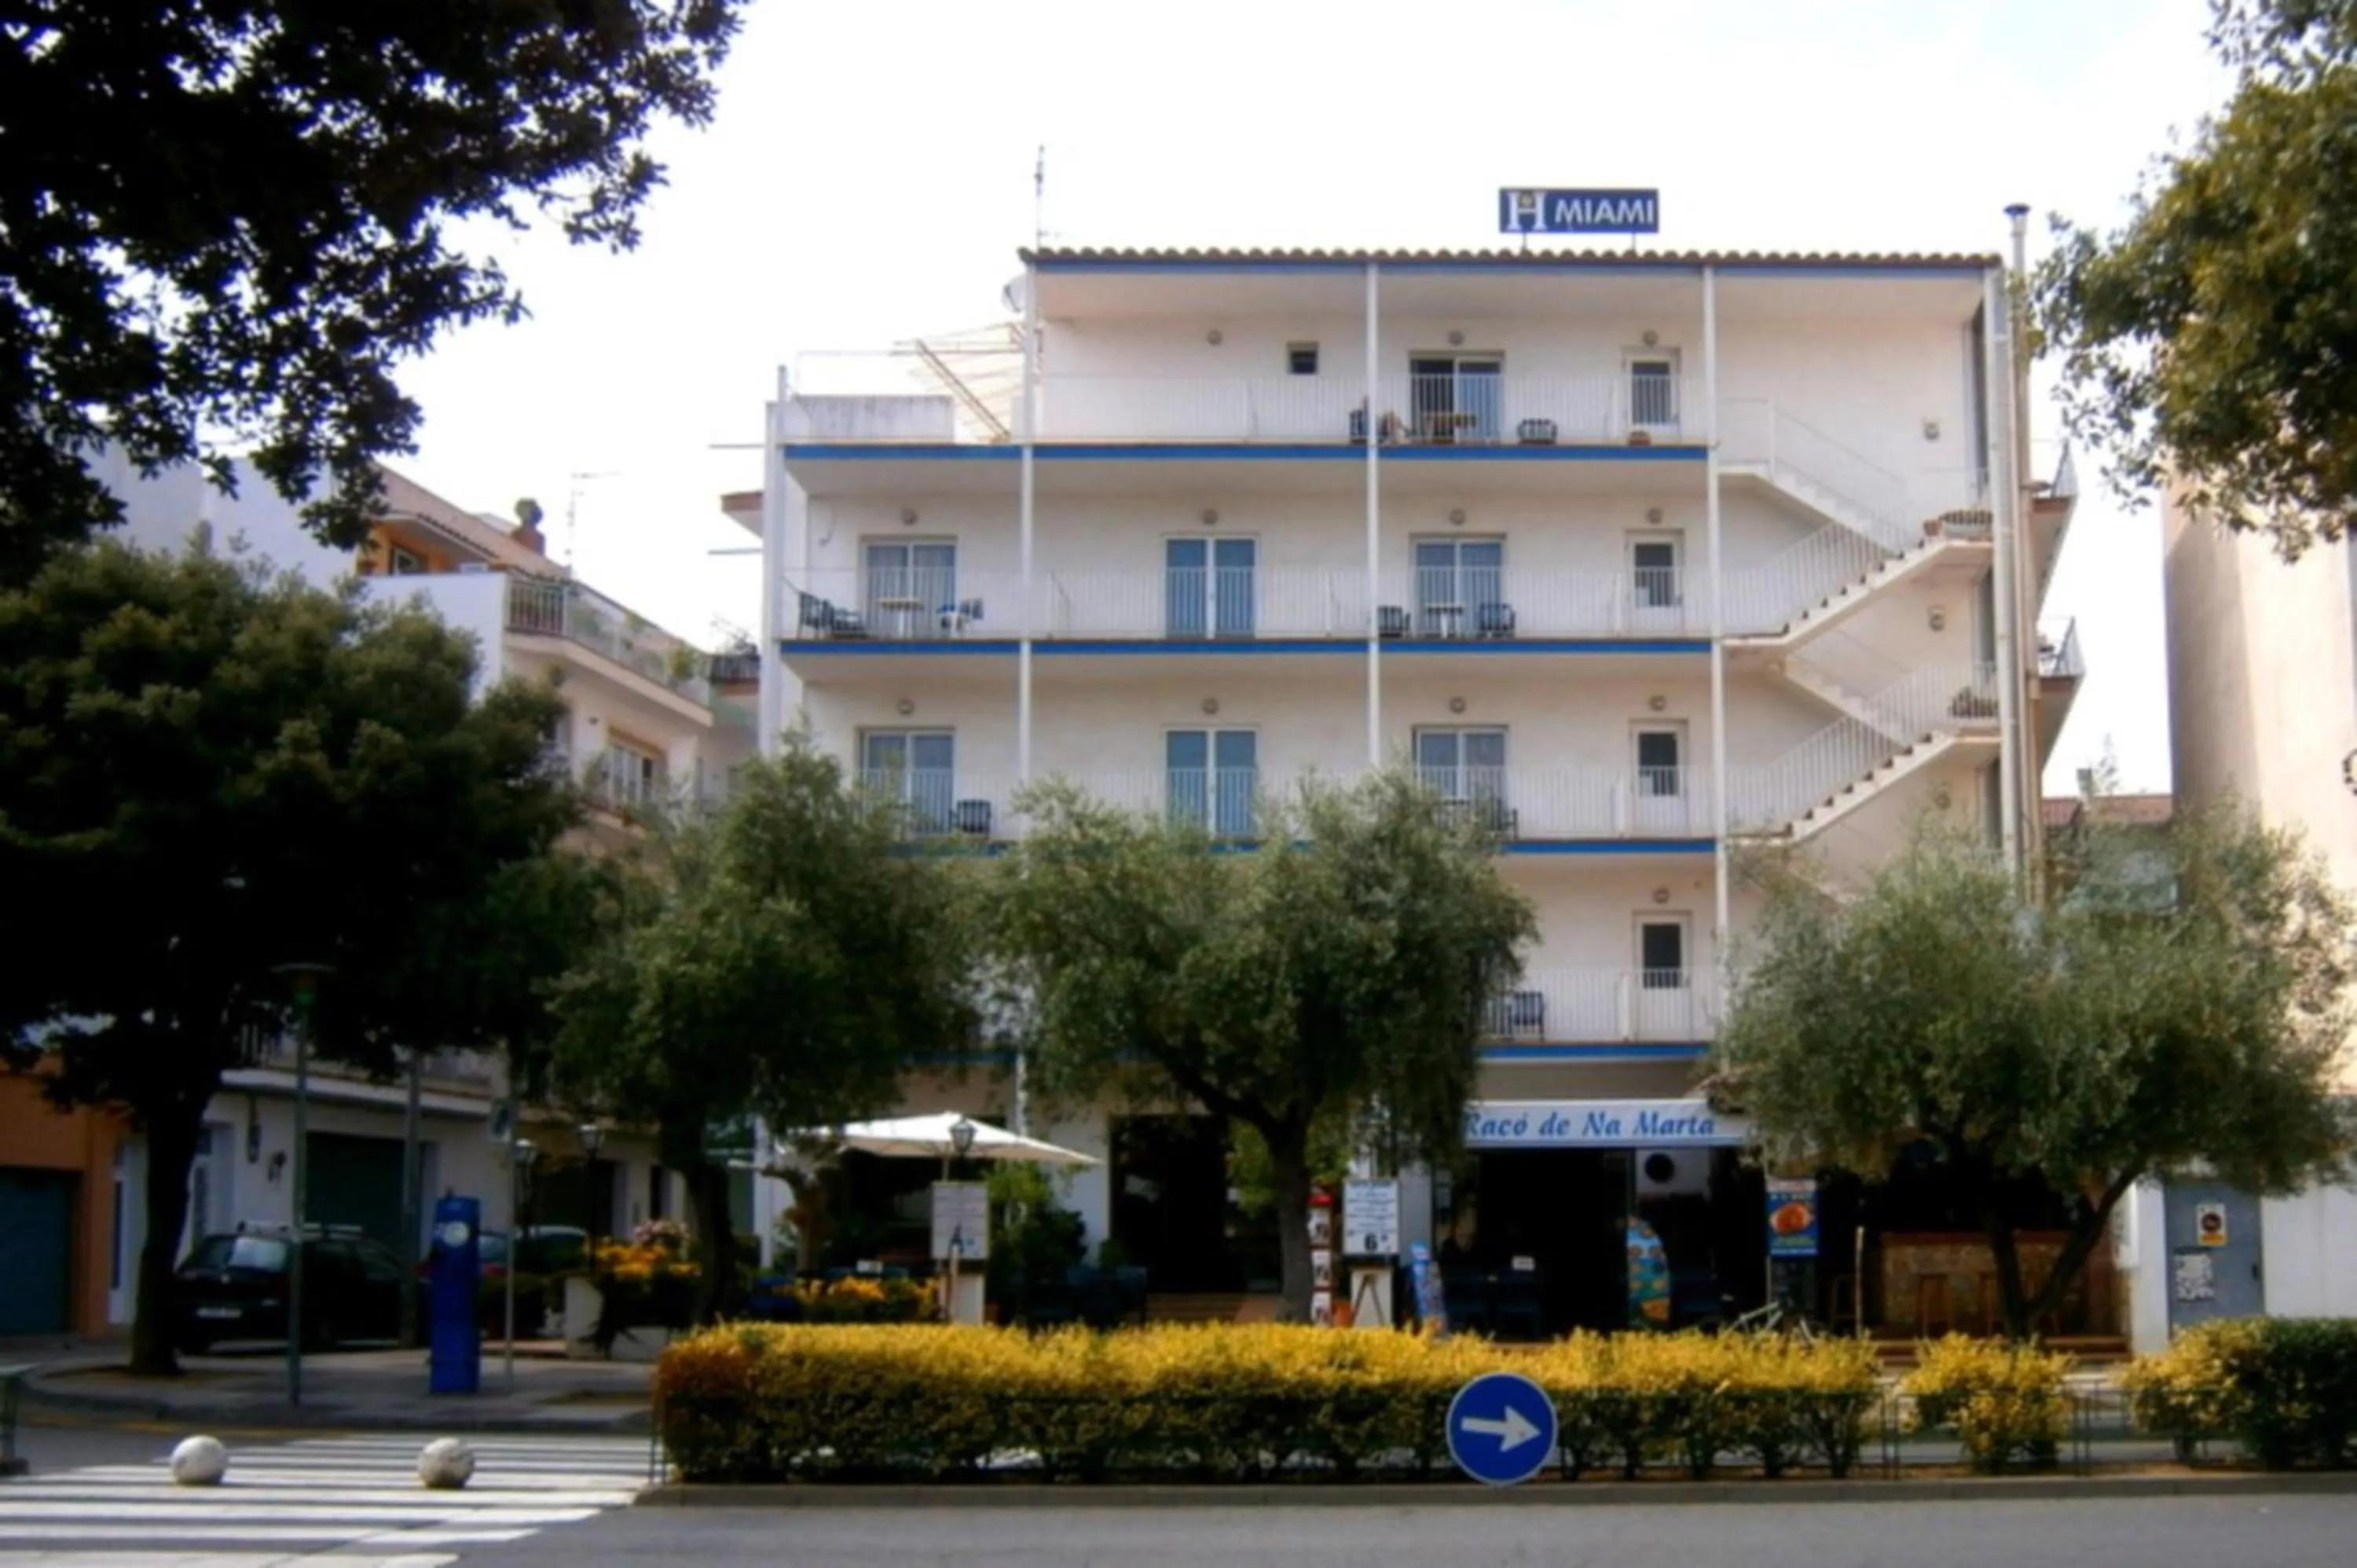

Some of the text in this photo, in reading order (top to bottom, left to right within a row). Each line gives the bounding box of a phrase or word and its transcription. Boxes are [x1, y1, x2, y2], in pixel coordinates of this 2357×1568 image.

[1554, 198, 1655, 225] MIAMI
[1463, 1109, 1714, 1137] Racó de Na Marta
